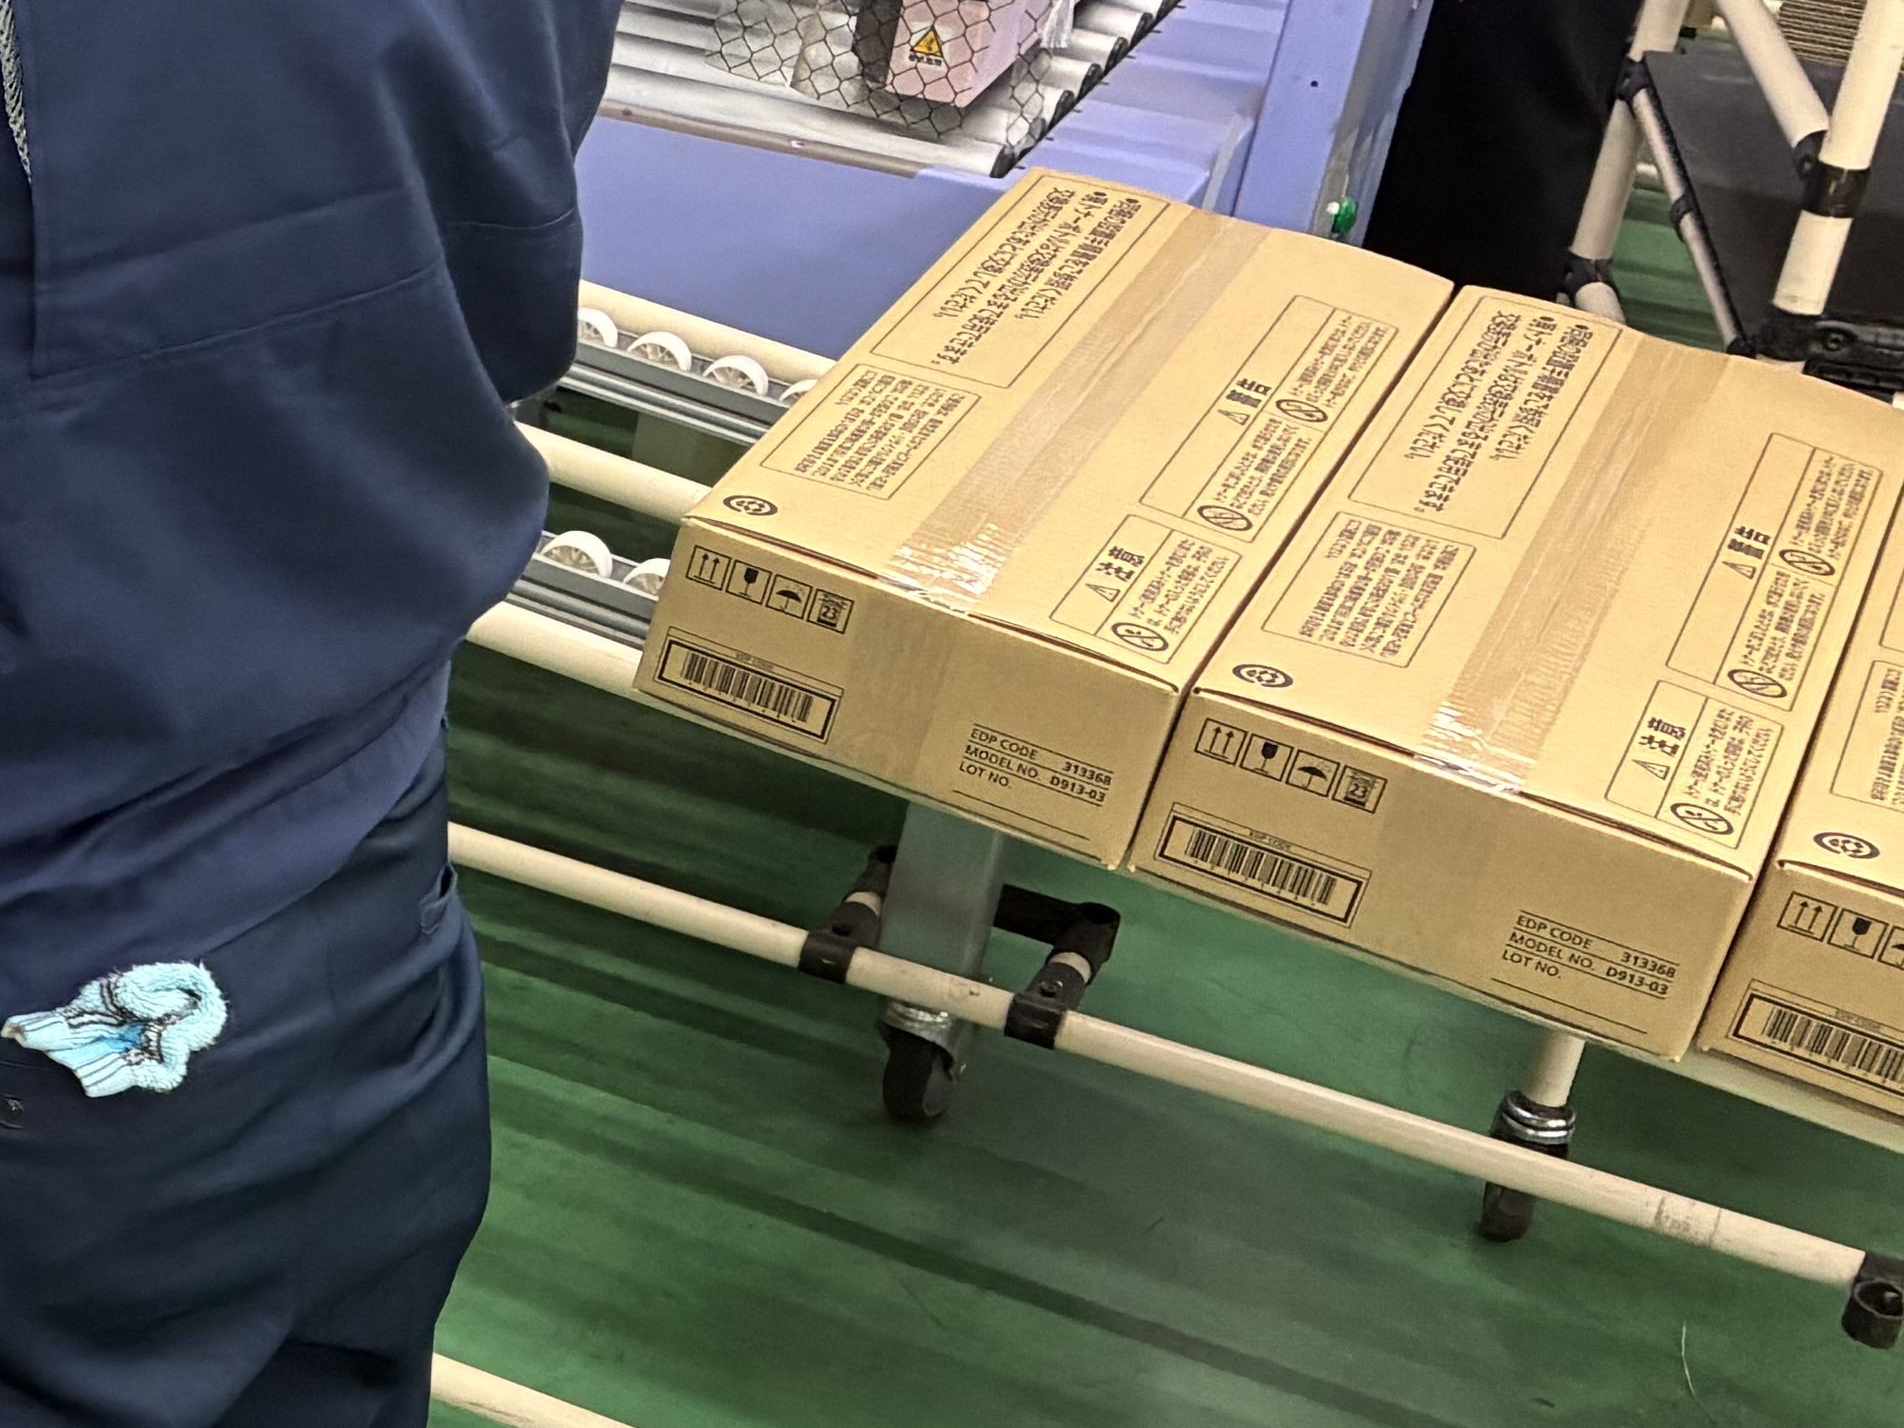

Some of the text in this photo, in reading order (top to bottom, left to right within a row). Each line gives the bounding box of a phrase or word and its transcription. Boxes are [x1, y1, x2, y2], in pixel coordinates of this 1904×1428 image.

[1092, 545, 1148, 582] 注意
[970, 727, 1112, 786] EDP CODE 313368
[1637, 715, 1687, 757] 注意
[960, 761, 986, 778] LOT
[965, 745, 1013, 769] MODEL
[1050, 776, 1106, 802] D913-03
[1502, 950, 1532, 965] LOT
[1509, 932, 1563, 959] MODEL
[1606, 967, 1669, 995] D913-03
[1516, 915, 1677, 978] EDP CODE 313368
